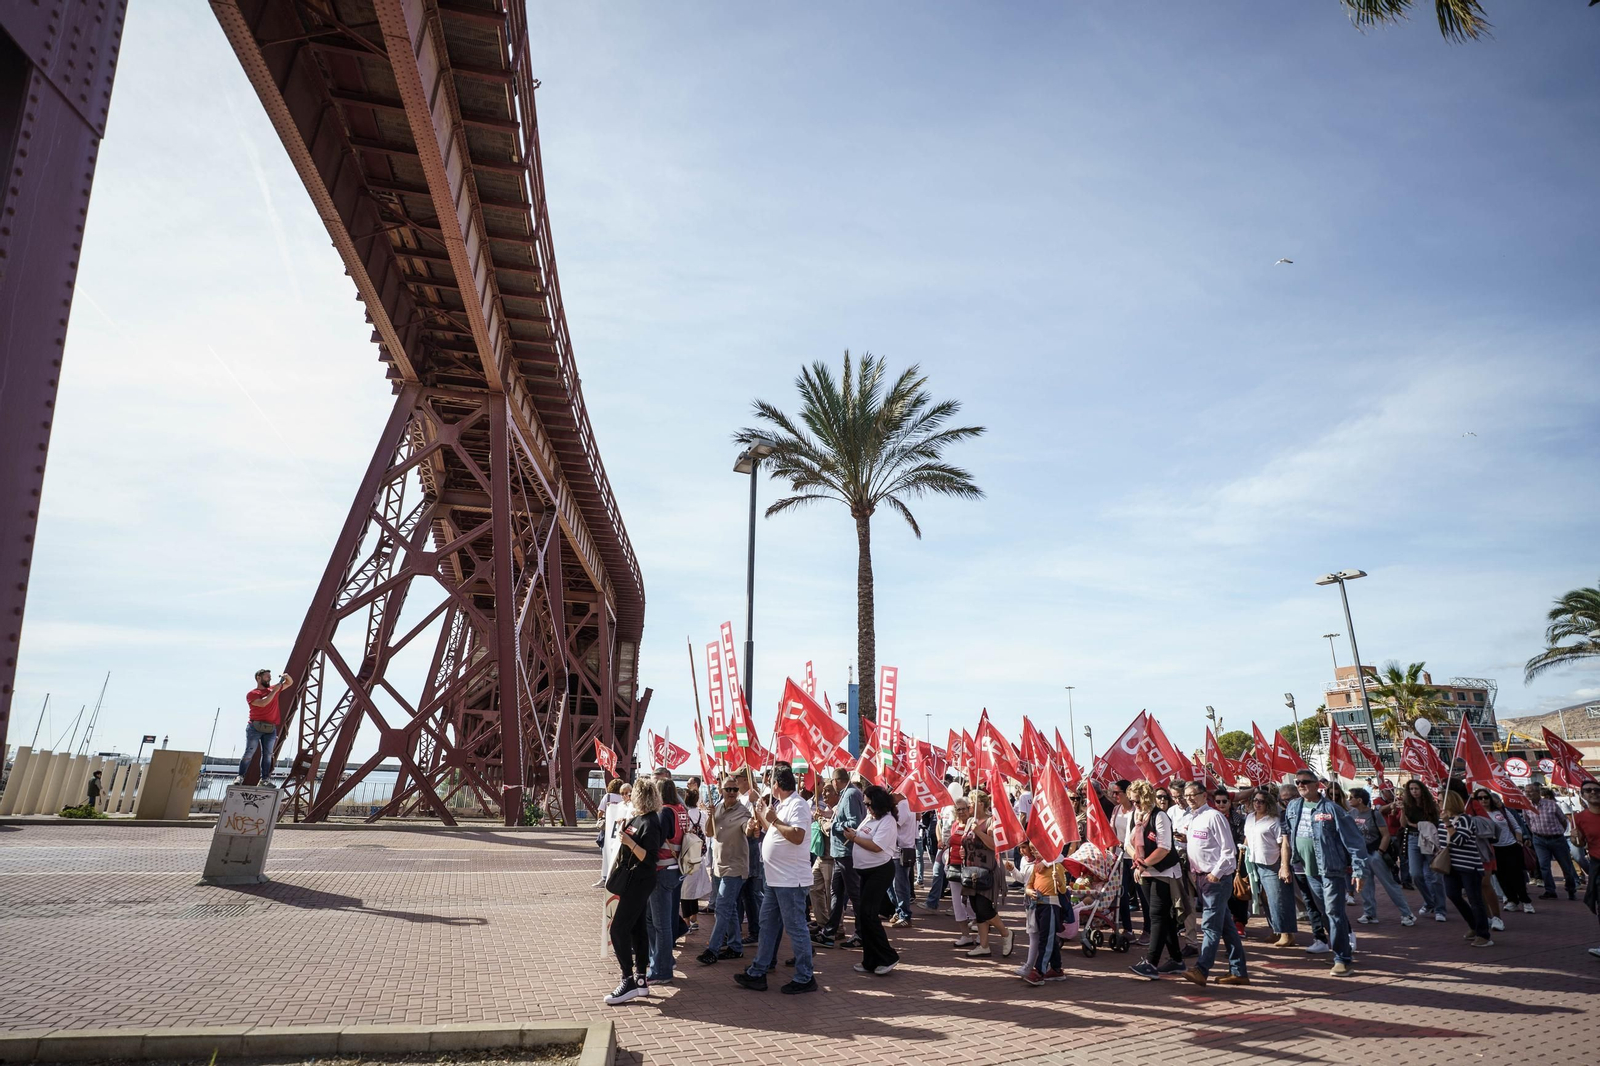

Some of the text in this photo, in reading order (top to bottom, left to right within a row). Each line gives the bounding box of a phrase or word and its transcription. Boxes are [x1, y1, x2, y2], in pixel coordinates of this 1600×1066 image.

[707, 646, 724, 733] CCOO
[722, 626, 743, 724] CCOO
[879, 669, 895, 749] CCOO
[908, 739, 918, 770] UGT
